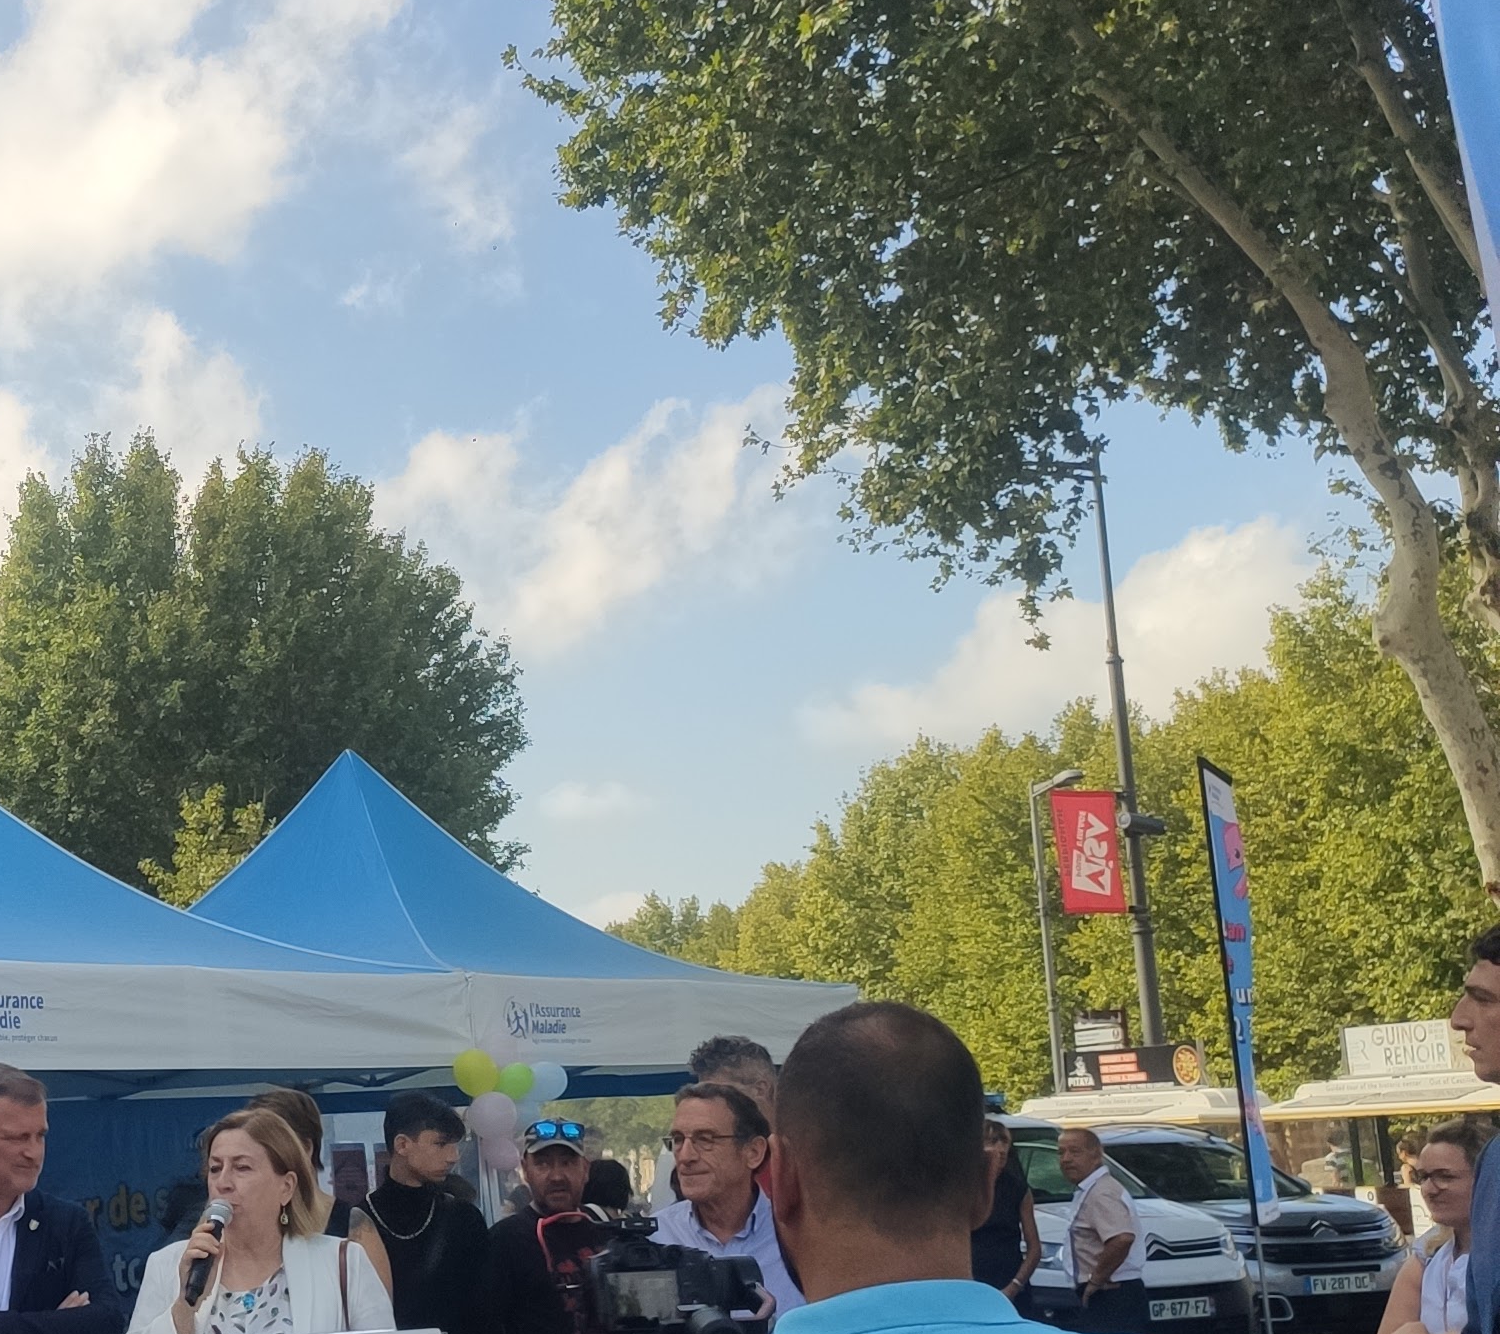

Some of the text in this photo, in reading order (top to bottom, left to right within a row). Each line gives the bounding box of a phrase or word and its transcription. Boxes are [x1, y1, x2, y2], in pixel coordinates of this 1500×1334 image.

[529, 1002, 581, 1018] l'Assurance
[532, 1019, 567, 1035] Maladie
[1371, 1024, 1427, 1046] GUINO
[1384, 1042, 1446, 1066] RENOIR
